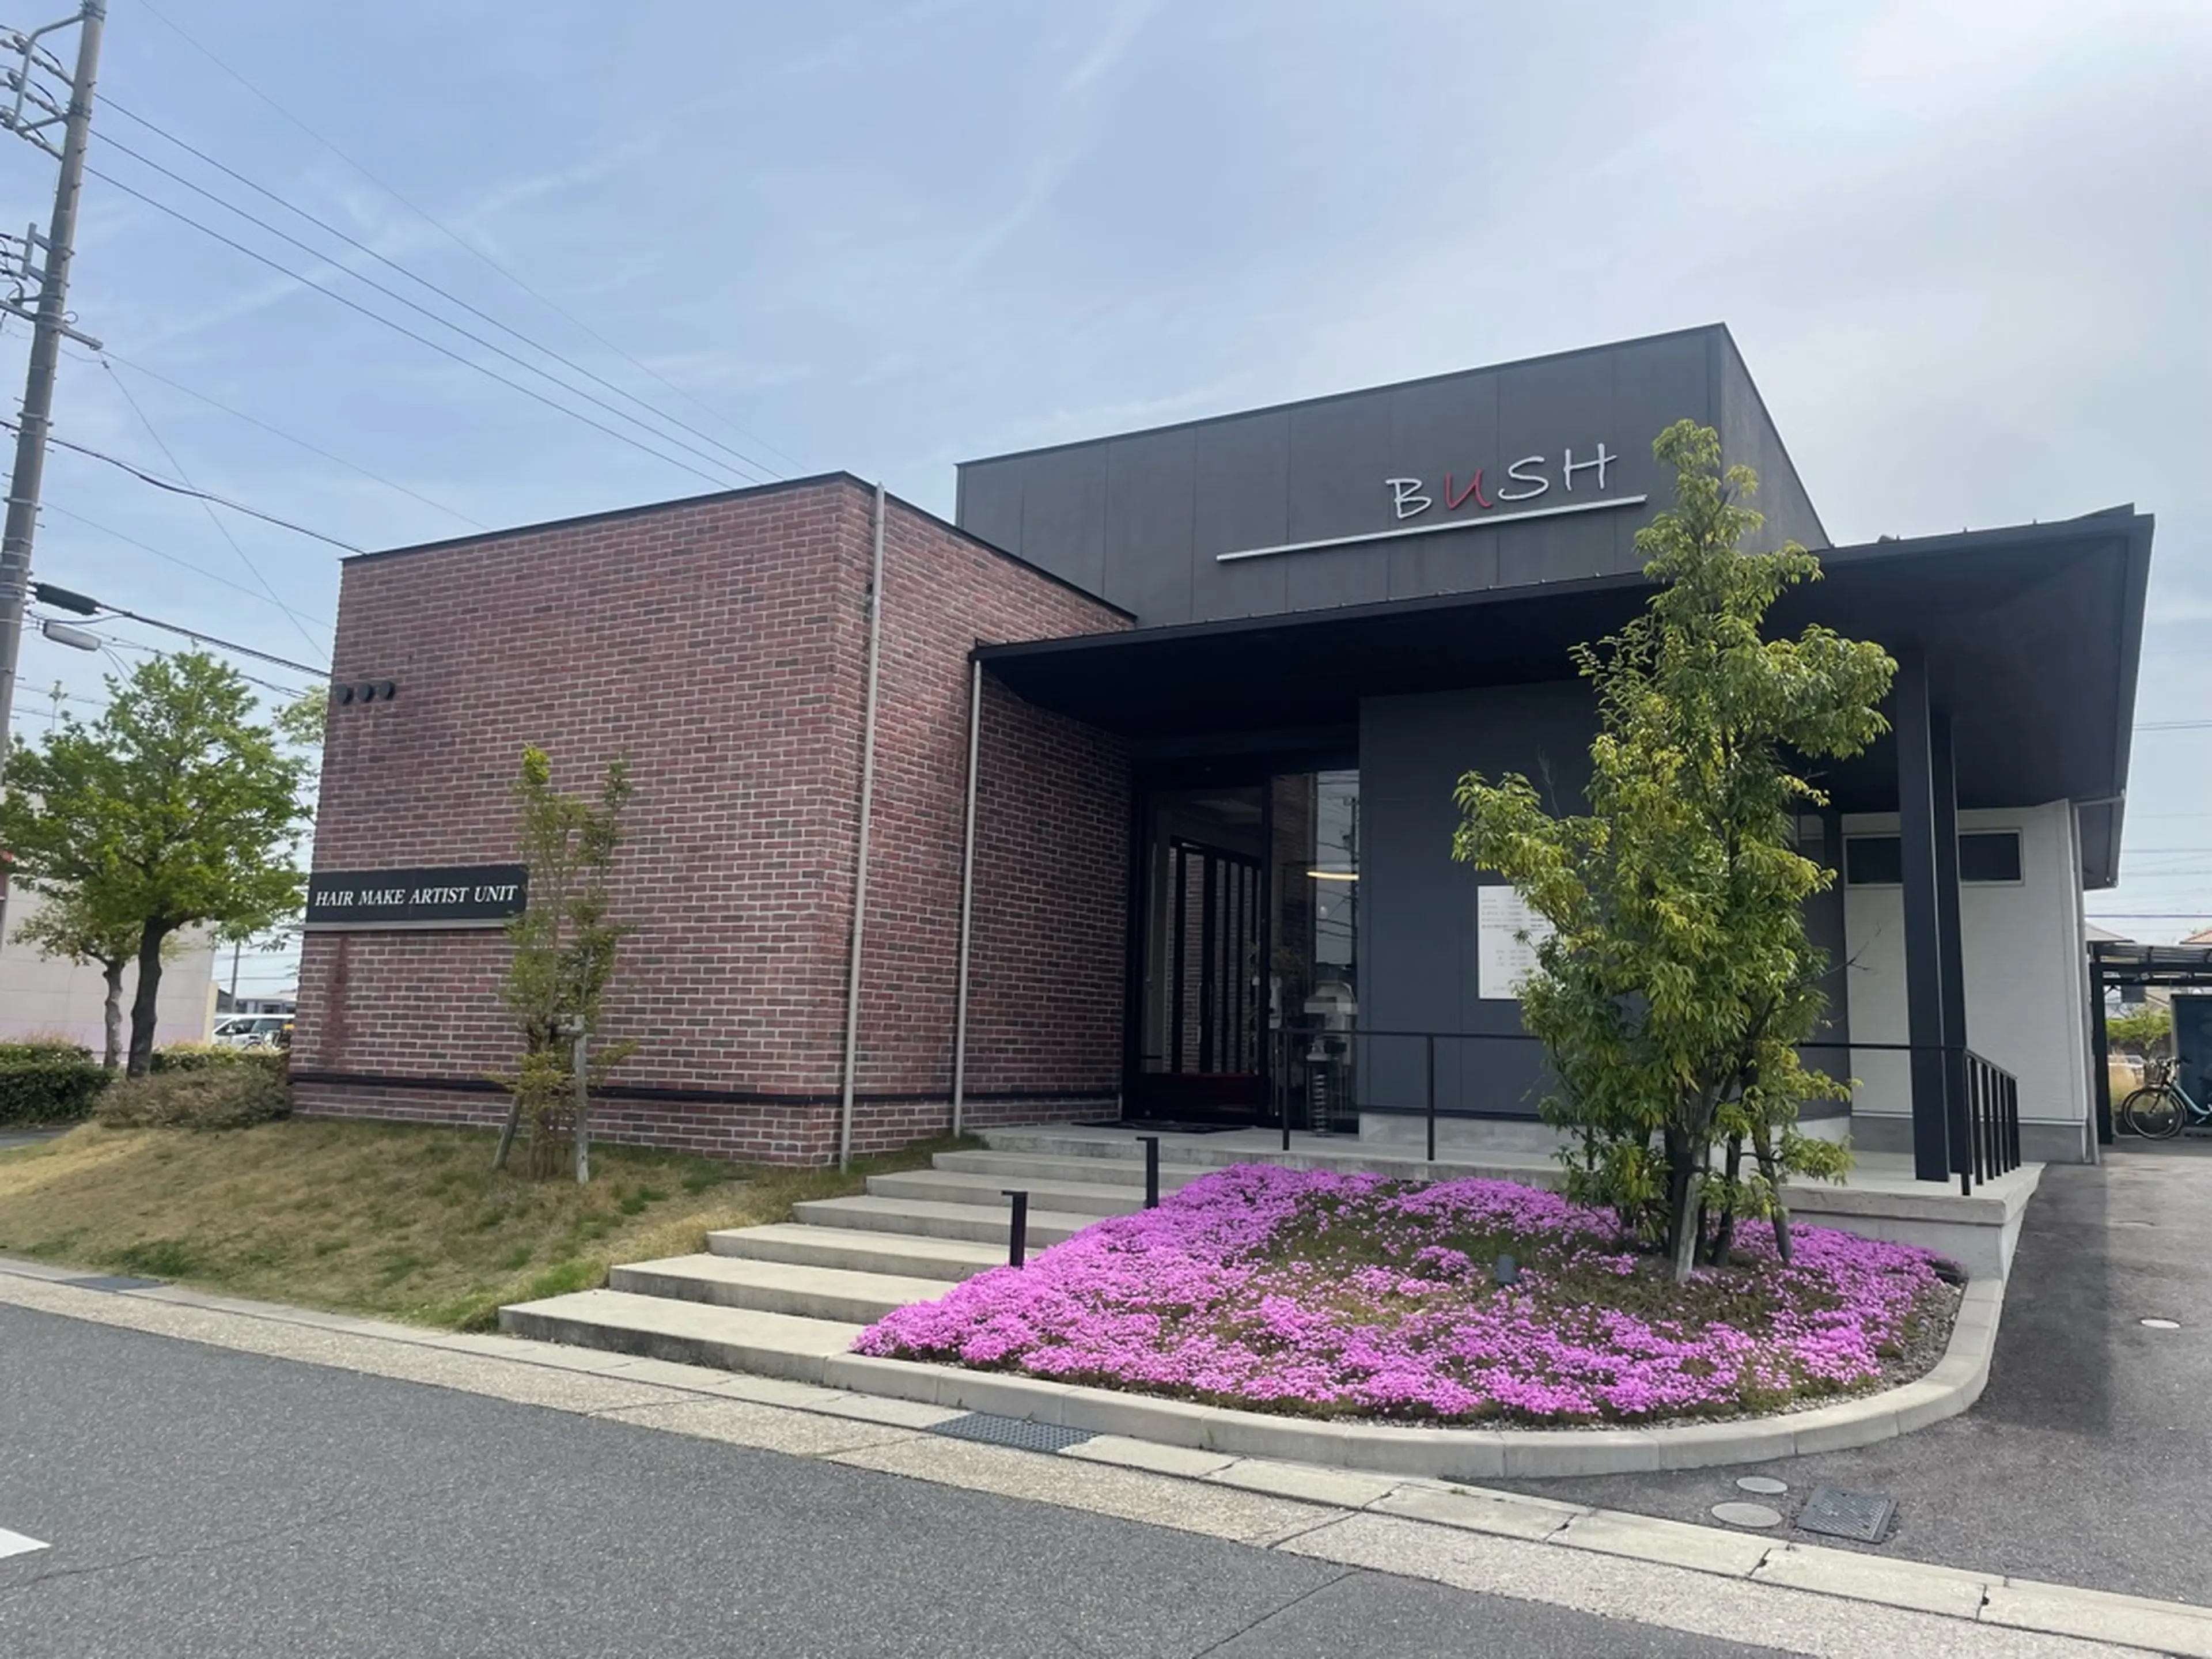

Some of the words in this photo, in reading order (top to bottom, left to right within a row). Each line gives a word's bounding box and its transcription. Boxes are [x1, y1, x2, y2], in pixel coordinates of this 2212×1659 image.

[1385, 443, 1617, 518] BUSH
[315, 891, 353, 906] HAIR
[358, 889, 405, 906] MAKE
[408, 887, 468, 904] ARTIST
[474, 885, 518, 902] UNIT
